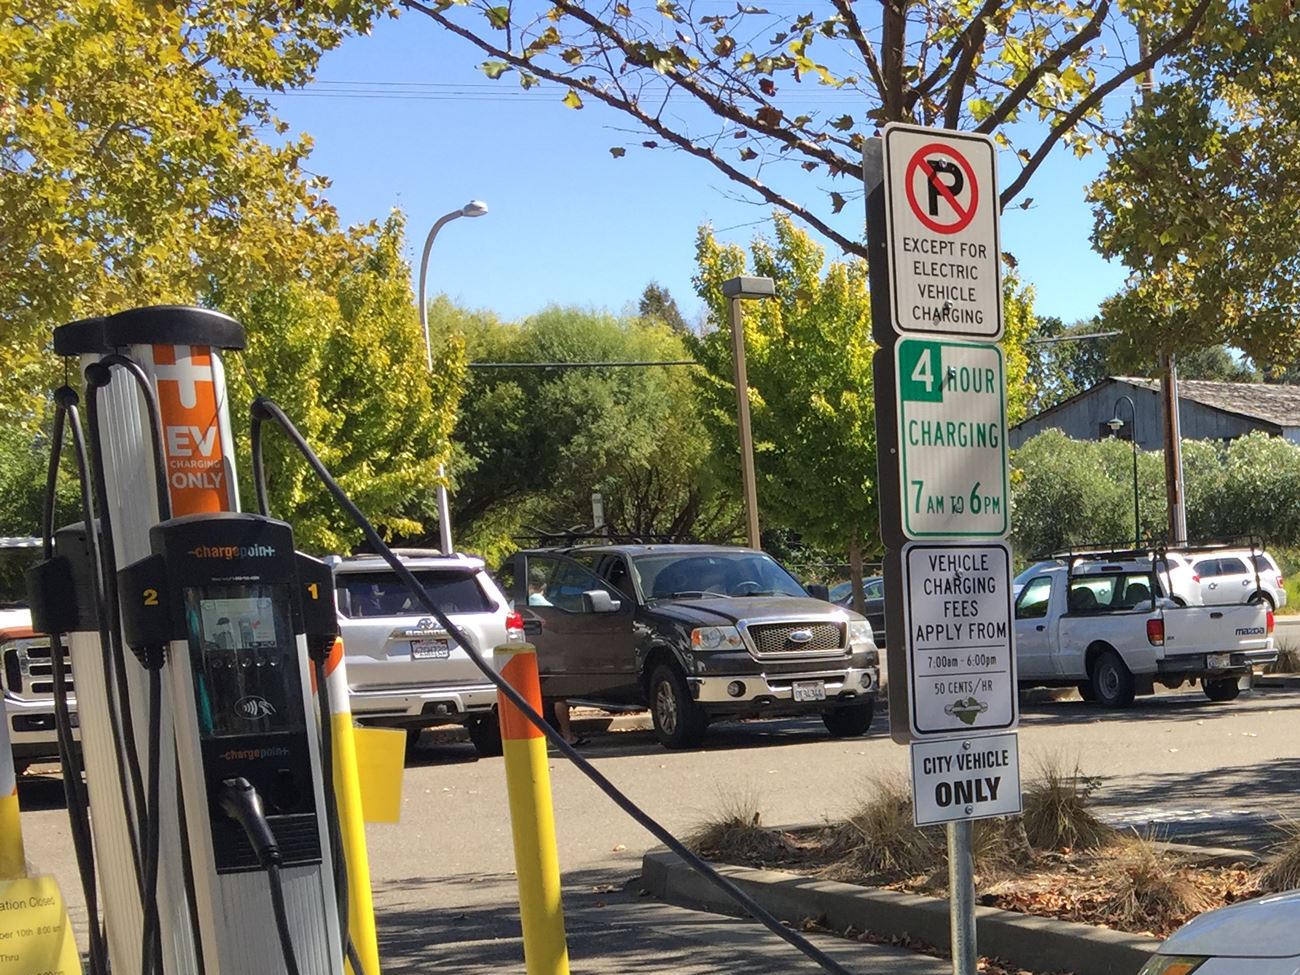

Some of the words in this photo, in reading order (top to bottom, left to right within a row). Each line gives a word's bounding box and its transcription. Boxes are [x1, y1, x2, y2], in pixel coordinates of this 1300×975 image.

[903, 237, 955, 256] EXCEPT
[960, 242, 987, 259] FOR
[913, 261, 979, 280] ELECTRIC
[917, 283, 976, 302] VEHICLE
[912, 305, 984, 324] CHARGING
[911, 348, 934, 393] 4
[947, 365, 995, 394] HOUR
[167, 426, 217, 457] EV
[908, 419, 999, 449] CHARGING
[170, 459, 221, 469] CHARGING
[171, 472, 223, 489] ONLY
[950, 495, 964, 514] TO
[928, 554, 989, 572] VEHICLE
[307, 583, 319, 600] 1
[923, 576, 996, 596] CHARGING
[143, 589, 159, 606] 2
[943, 600, 979, 618] FEES
[916, 623, 963, 642] APPLY
[969, 621, 1007, 640] FROM
[1235, 627, 1265, 636] mazda
[928, 656, 959, 669] 7:00am
[966, 654, 997, 667] 6:00pm
[934, 682, 945, 695] 50
[923, 755, 953, 775] CITY
[956, 750, 1009, 771] VEHICLE
[935, 776, 1002, 808] ONLY
